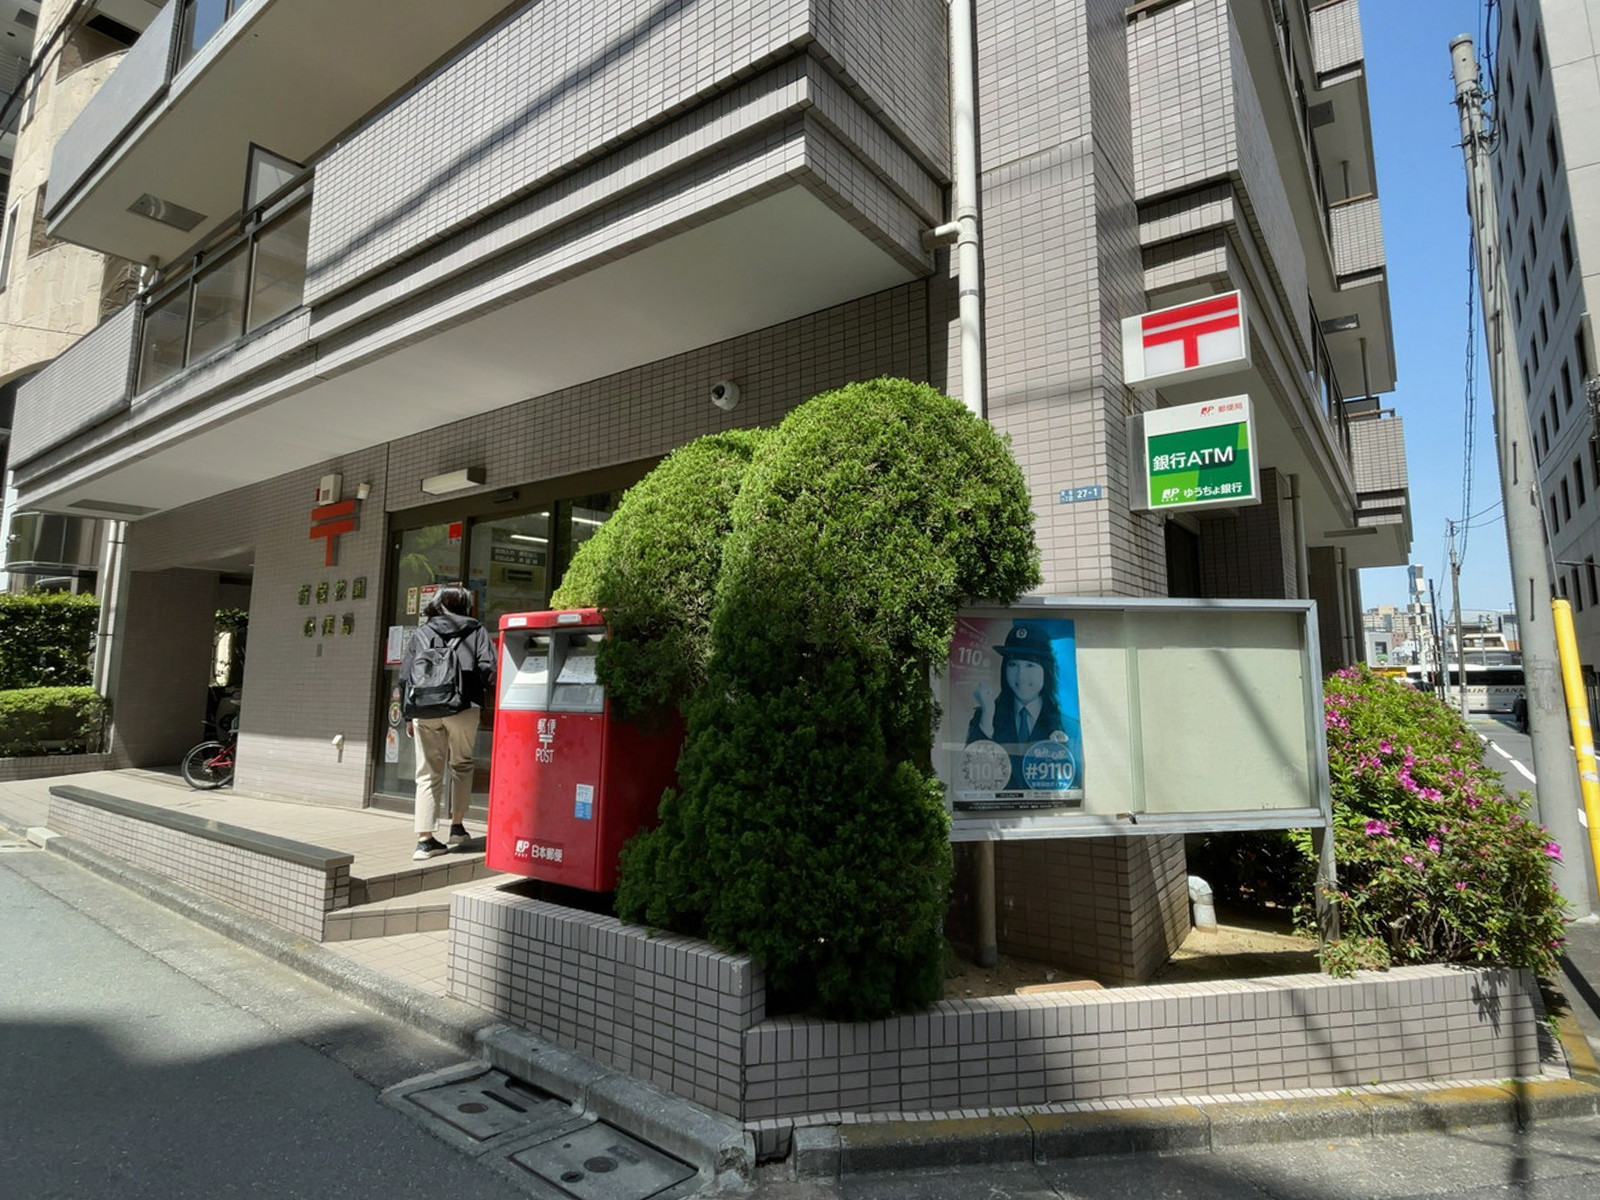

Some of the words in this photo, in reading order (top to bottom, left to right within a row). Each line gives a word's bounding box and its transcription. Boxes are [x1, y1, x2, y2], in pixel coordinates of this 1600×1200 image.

[1152, 446, 1234, 472] 銀行ATM
[1076, 487, 1098, 499] 27-1
[1183, 482, 1243, 498] ゆうちょ銀行
[537, 718, 557, 735] 郵便
[535, 748, 555, 763] POST
[1026, 762, 1073, 780] #9110
[531, 844, 563, 862] 日本郵便
